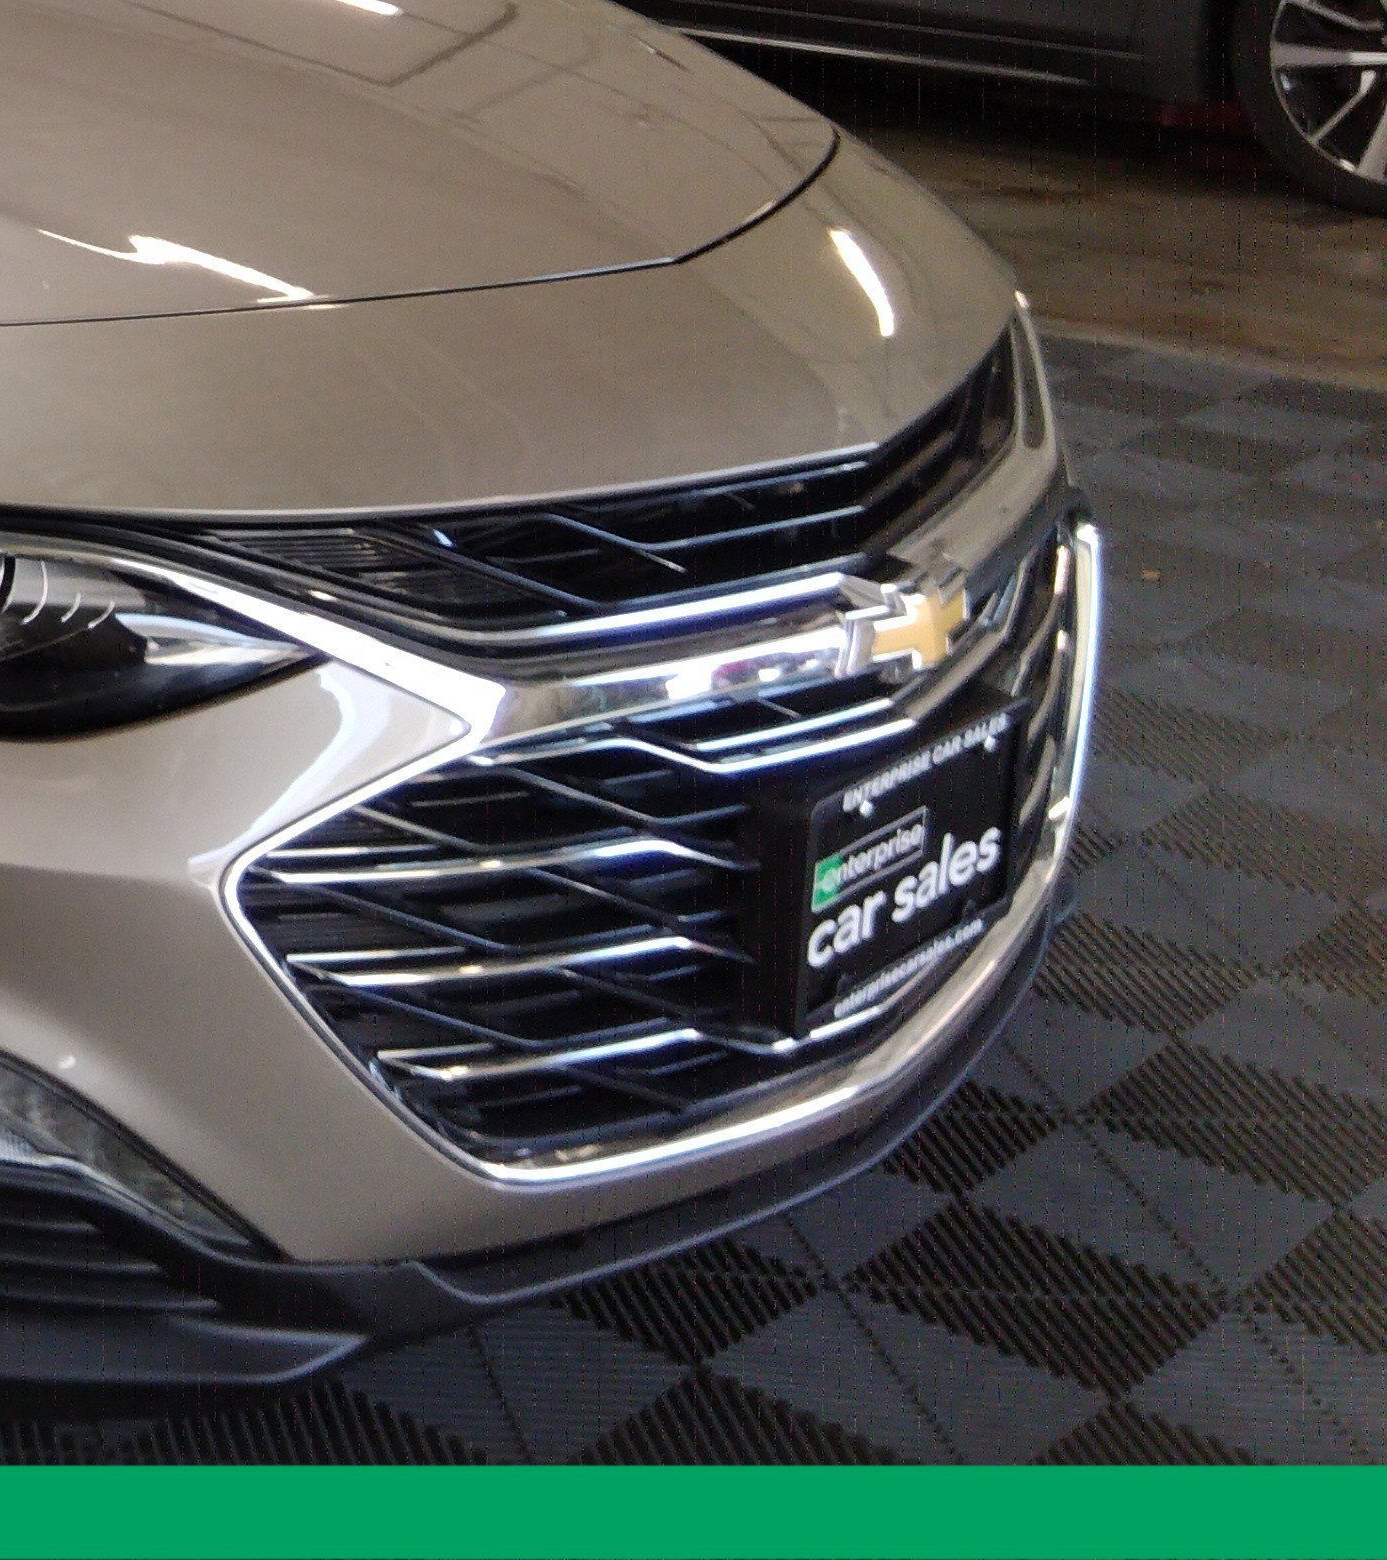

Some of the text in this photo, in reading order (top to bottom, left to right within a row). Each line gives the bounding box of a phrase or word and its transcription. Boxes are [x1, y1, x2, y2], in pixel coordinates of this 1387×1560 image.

[807, 826, 1001, 968] car sales
[819, 823, 925, 892] enterprise
